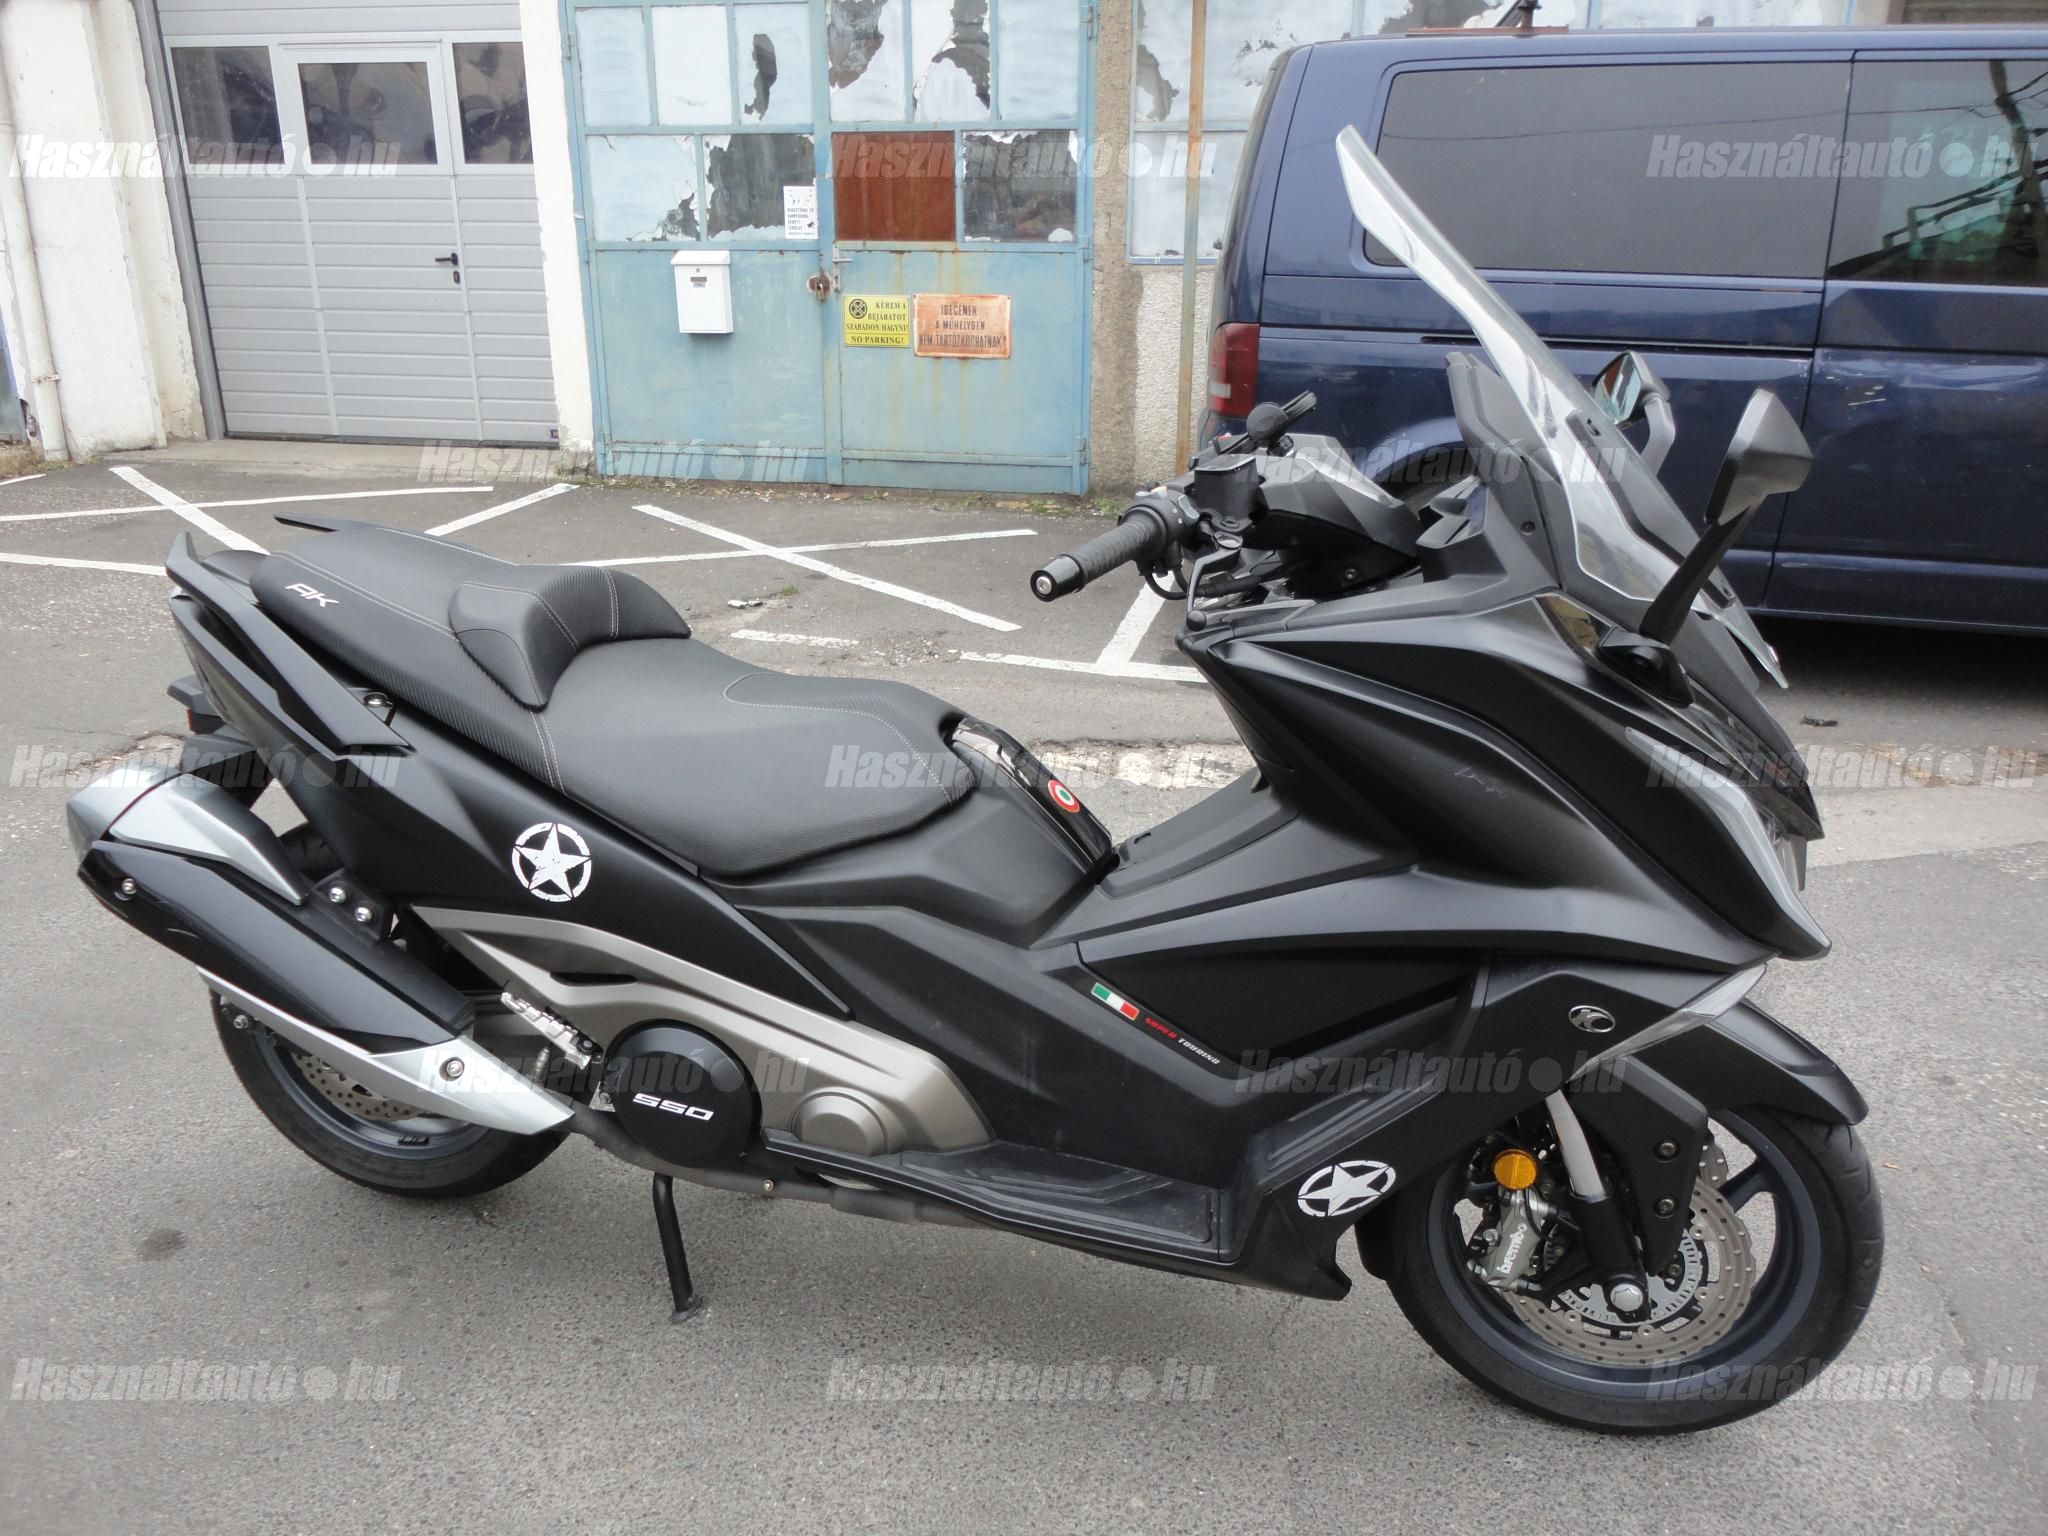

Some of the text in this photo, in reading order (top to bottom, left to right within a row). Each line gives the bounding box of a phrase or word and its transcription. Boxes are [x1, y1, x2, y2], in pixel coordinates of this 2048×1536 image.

[851, 335, 905, 345] NO PARKING!
[632, 1092, 715, 1121] 550
[1496, 1222, 1528, 1274] brembo
